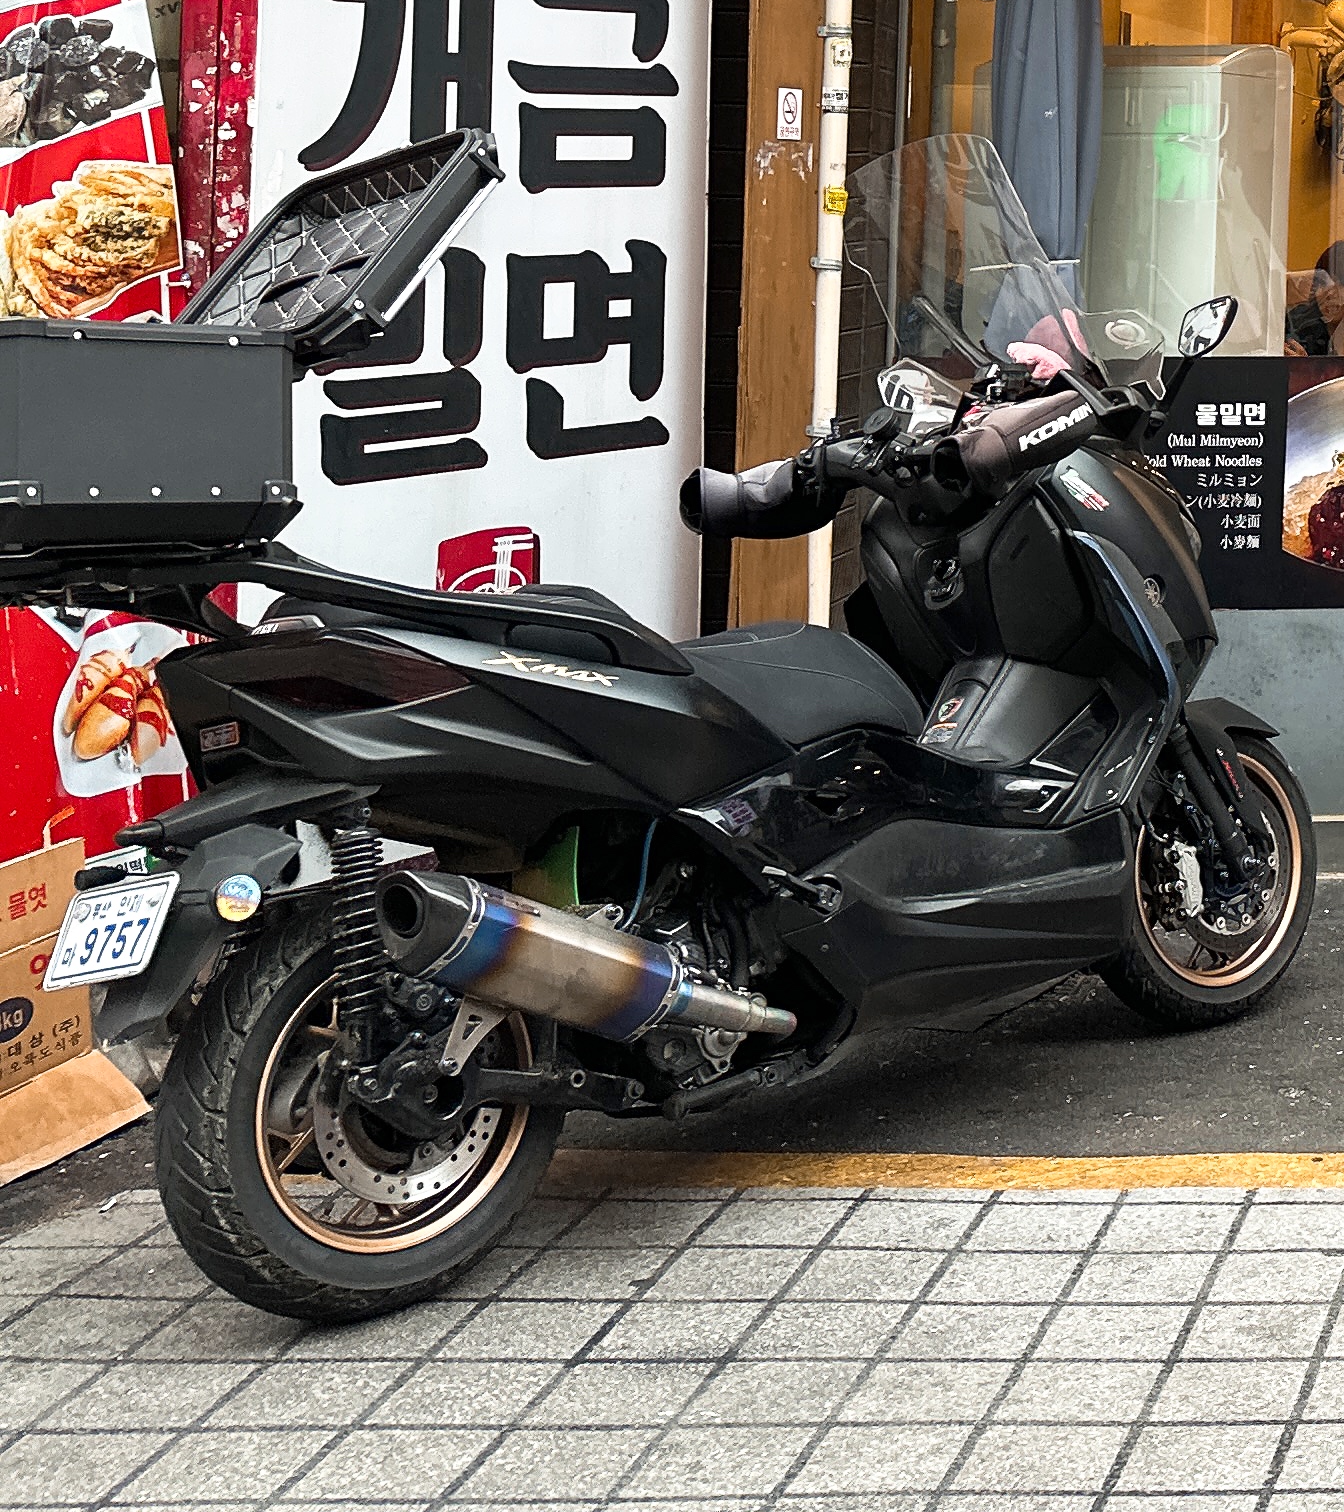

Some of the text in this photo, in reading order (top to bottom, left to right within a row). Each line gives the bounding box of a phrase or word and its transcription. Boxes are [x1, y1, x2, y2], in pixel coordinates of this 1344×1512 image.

[1167, 432, 1264, 449] (Mul Milmyeon)
[1171, 454, 1211, 467] Wheat
[1215, 454, 1263, 467] Noodles
[1197, 473, 1263, 488] ミルミョン
[8, 883, 48, 921] 물엿
[79, 917, 151, 967] 9757
[0, 1008, 24, 1033] kg
